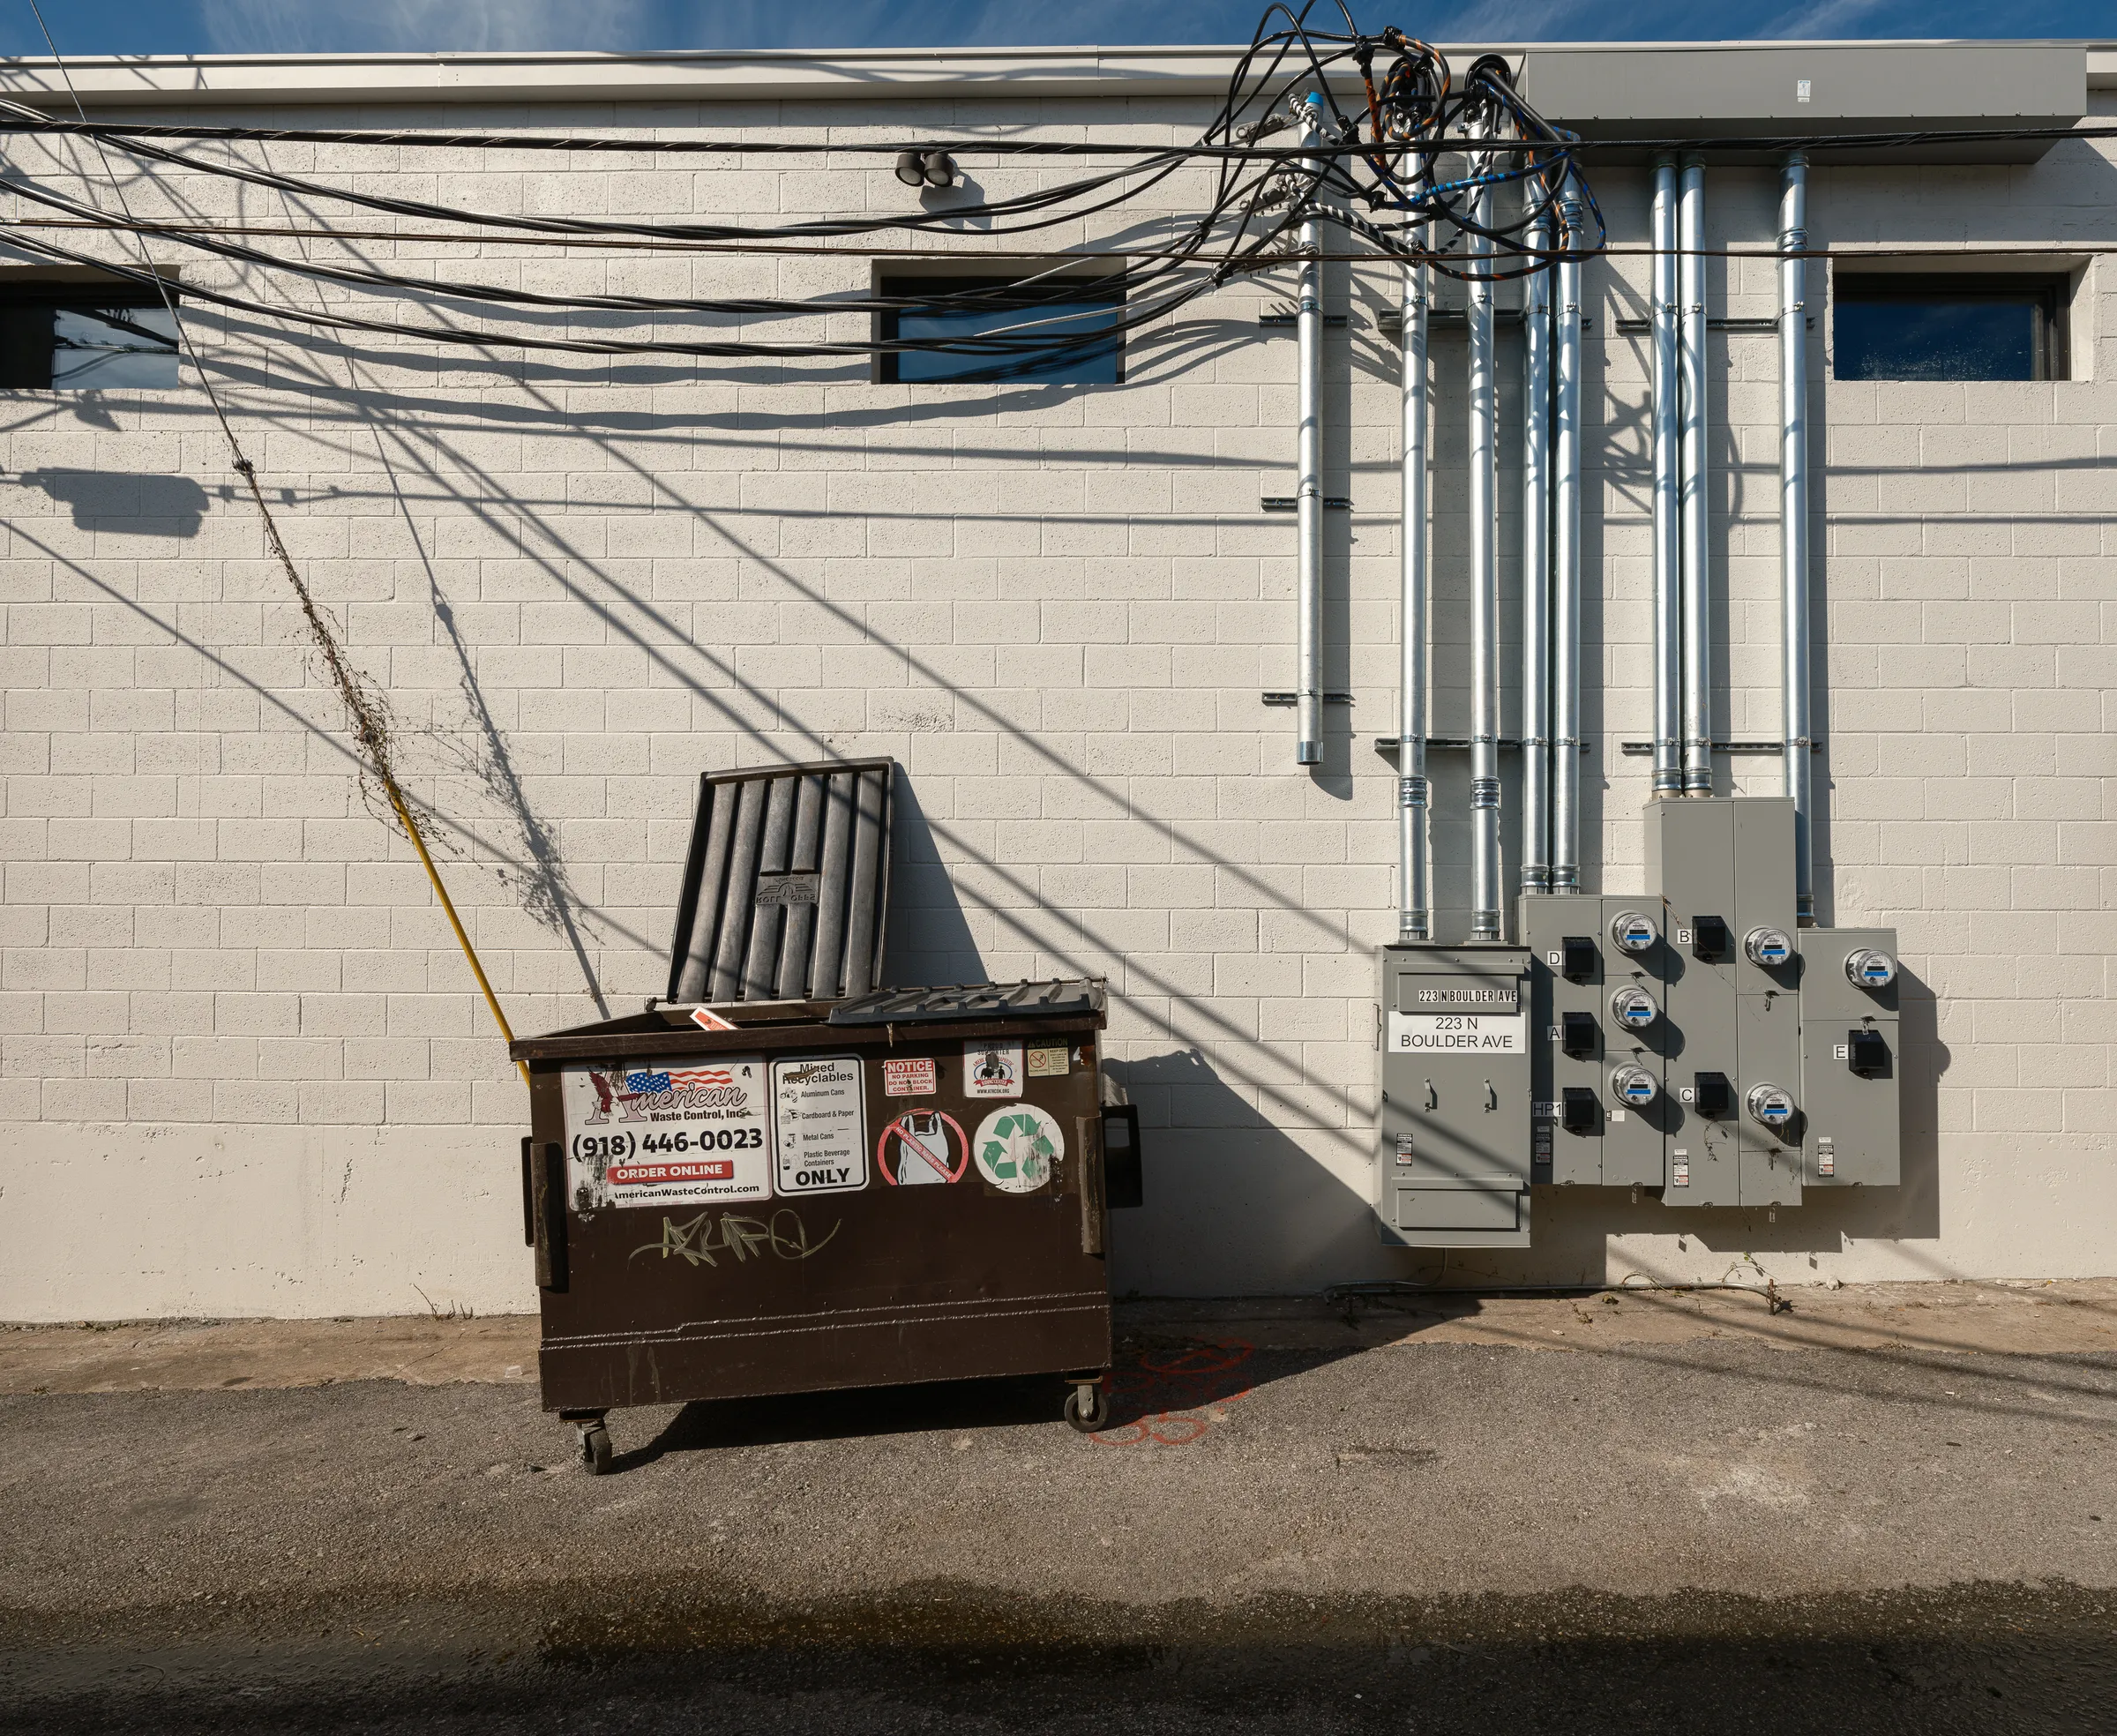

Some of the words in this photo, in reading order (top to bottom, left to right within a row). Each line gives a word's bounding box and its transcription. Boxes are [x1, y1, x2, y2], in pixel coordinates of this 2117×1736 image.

[1680, 931, 1689, 942] B
[1550, 953, 1560, 964] D
[1419, 991, 1438, 1002] 223
[1441, 991, 1447, 1002] N
[1450, 990, 1494, 1002] BOULDER
[1499, 990, 1516, 1002] AVE
[1435, 1017, 1462, 1029] 223
[1468, 1017, 1477, 1029] N
[1550, 1028, 1560, 1039] A
[1035, 1038, 1068, 1048] CAUTION
[1401, 1035, 1478, 1047] BOULDER
[1482, 1036, 1513, 1048] AVE
[1836, 1046, 1845, 1058] E
[887, 1060, 932, 1073] NOTICE
[585, 1067, 747, 1125] American
[1682, 1089, 1692, 1101] C
[650, 1112, 682, 1122] Waste
[684, 1110, 724, 1122] Control,
[1533, 1104, 1561, 1116] HP1
[572, 1131, 636, 1163] (918)
[642, 1128, 763, 1154] 446-0023
[895, 1126, 904, 1135] NO
[902, 1134, 922, 1152] PLASTIC
[922, 1149, 935, 1163] BAGS
[934, 1161, 953, 1179] PLEASE
[804, 1158, 834, 1167] Containers
[617, 1167, 666, 1179] ORDER
[670, 1164, 722, 1176] ONLINE
[796, 1168, 850, 1186] ONLY
